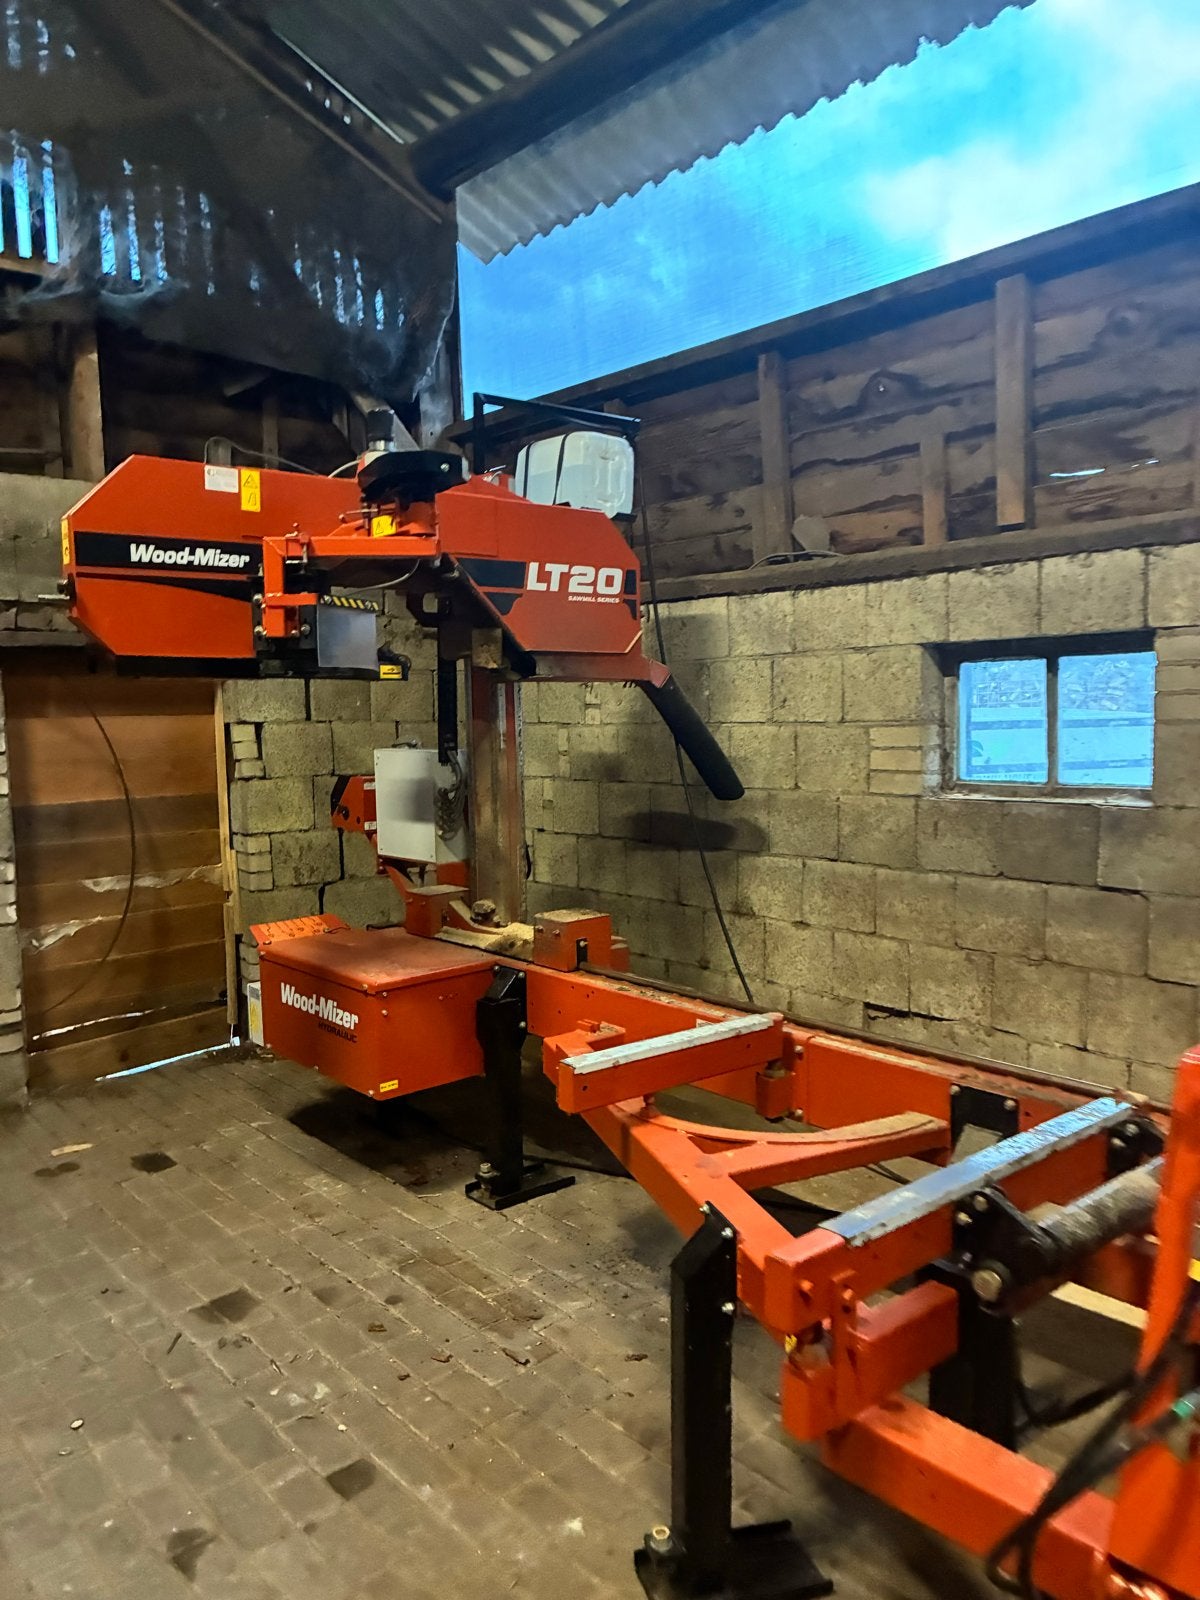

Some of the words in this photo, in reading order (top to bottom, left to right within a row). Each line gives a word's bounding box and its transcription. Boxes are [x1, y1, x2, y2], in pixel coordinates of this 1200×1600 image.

[130, 543, 250, 568] Wood-Mizer
[527, 562, 623, 595] LT20
[568, 595, 596, 603] SAWMILL
[281, 982, 359, 1030] Wood-Mizer
